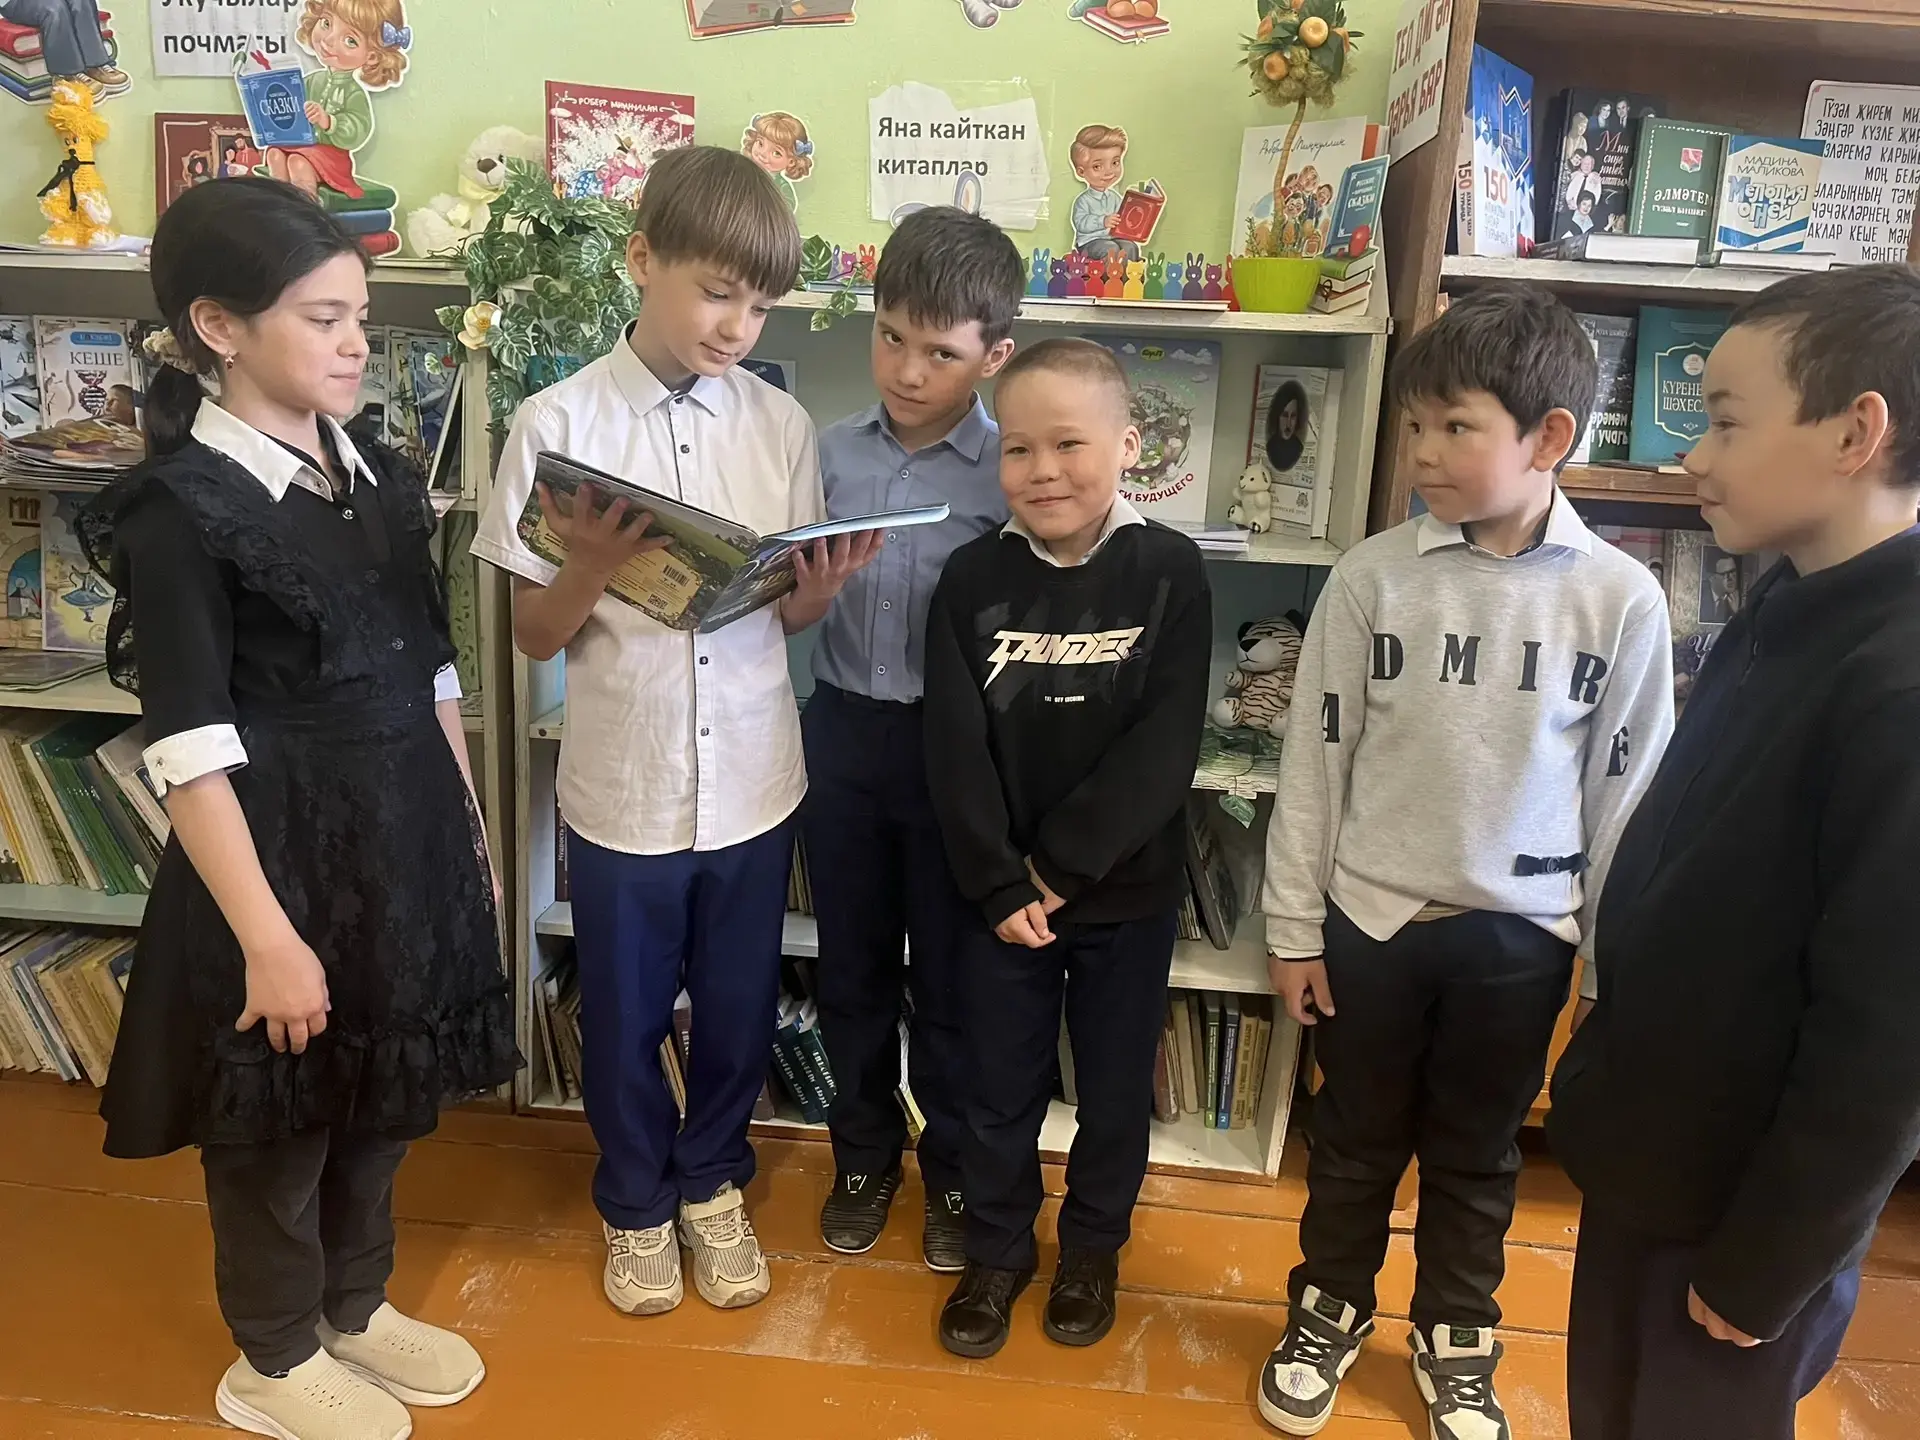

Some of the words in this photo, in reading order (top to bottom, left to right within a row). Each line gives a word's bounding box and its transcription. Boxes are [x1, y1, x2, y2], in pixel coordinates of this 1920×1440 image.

[164, 34, 287, 54] почмаы
[260, 96, 301, 115] СКАЗКИ
[1823, 98, 1850, 119] ГҮЗӘЛ
[1856, 103, 1893, 121] ҖИРЕМ
[1903, 106, 1920, 124] МИ
[878, 116, 922, 138] Яна
[930, 117, 1026, 140] кайткан
[1815, 119, 1855, 139] ЗӘҢГӘР
[1861, 124, 1895, 141] КҮЗЛЕ
[1595, 130, 1630, 154] Мин
[1744, 155, 1799, 167] МАДИНА
[1880, 144, 1920, 166] КАРЫЙ
[878, 158, 989, 177] китаплар
[1458, 160, 1472, 190] 150
[1737, 165, 1805, 177] МАЛИКОВА
[1864, 166, 1889, 185] МОҢ
[1483, 165, 1508, 205] 150
[1849, 225, 1878, 243] КЕШЕ
[69, 351, 125, 367] КЕШЕ
[1662, 396, 1708, 413] ШӘХЕС
[1135, 473, 1194, 504] БУДУЩЕГО
